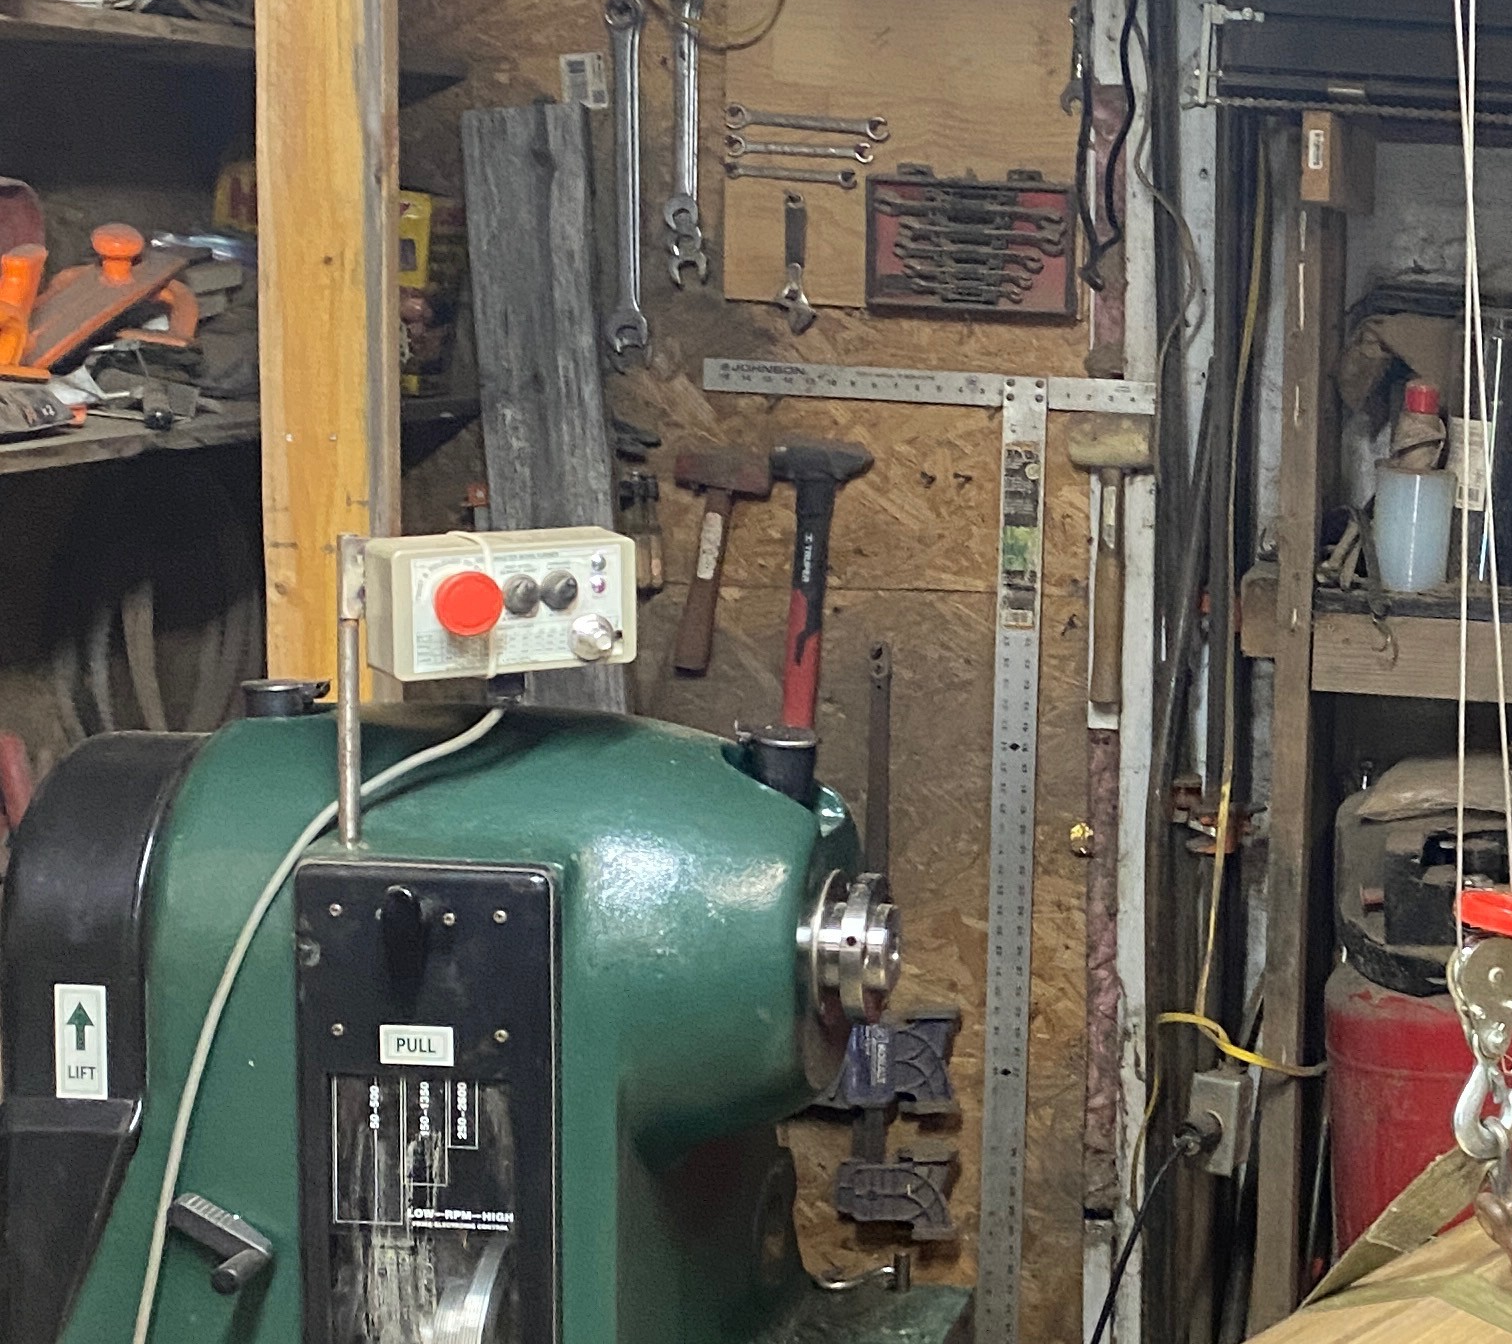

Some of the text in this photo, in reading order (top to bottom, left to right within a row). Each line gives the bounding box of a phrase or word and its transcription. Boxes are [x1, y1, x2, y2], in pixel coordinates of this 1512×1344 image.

[732, 362, 805, 375] JOHNSON
[396, 1037, 437, 1053] PULL
[67, 1065, 97, 1080] LIFT
